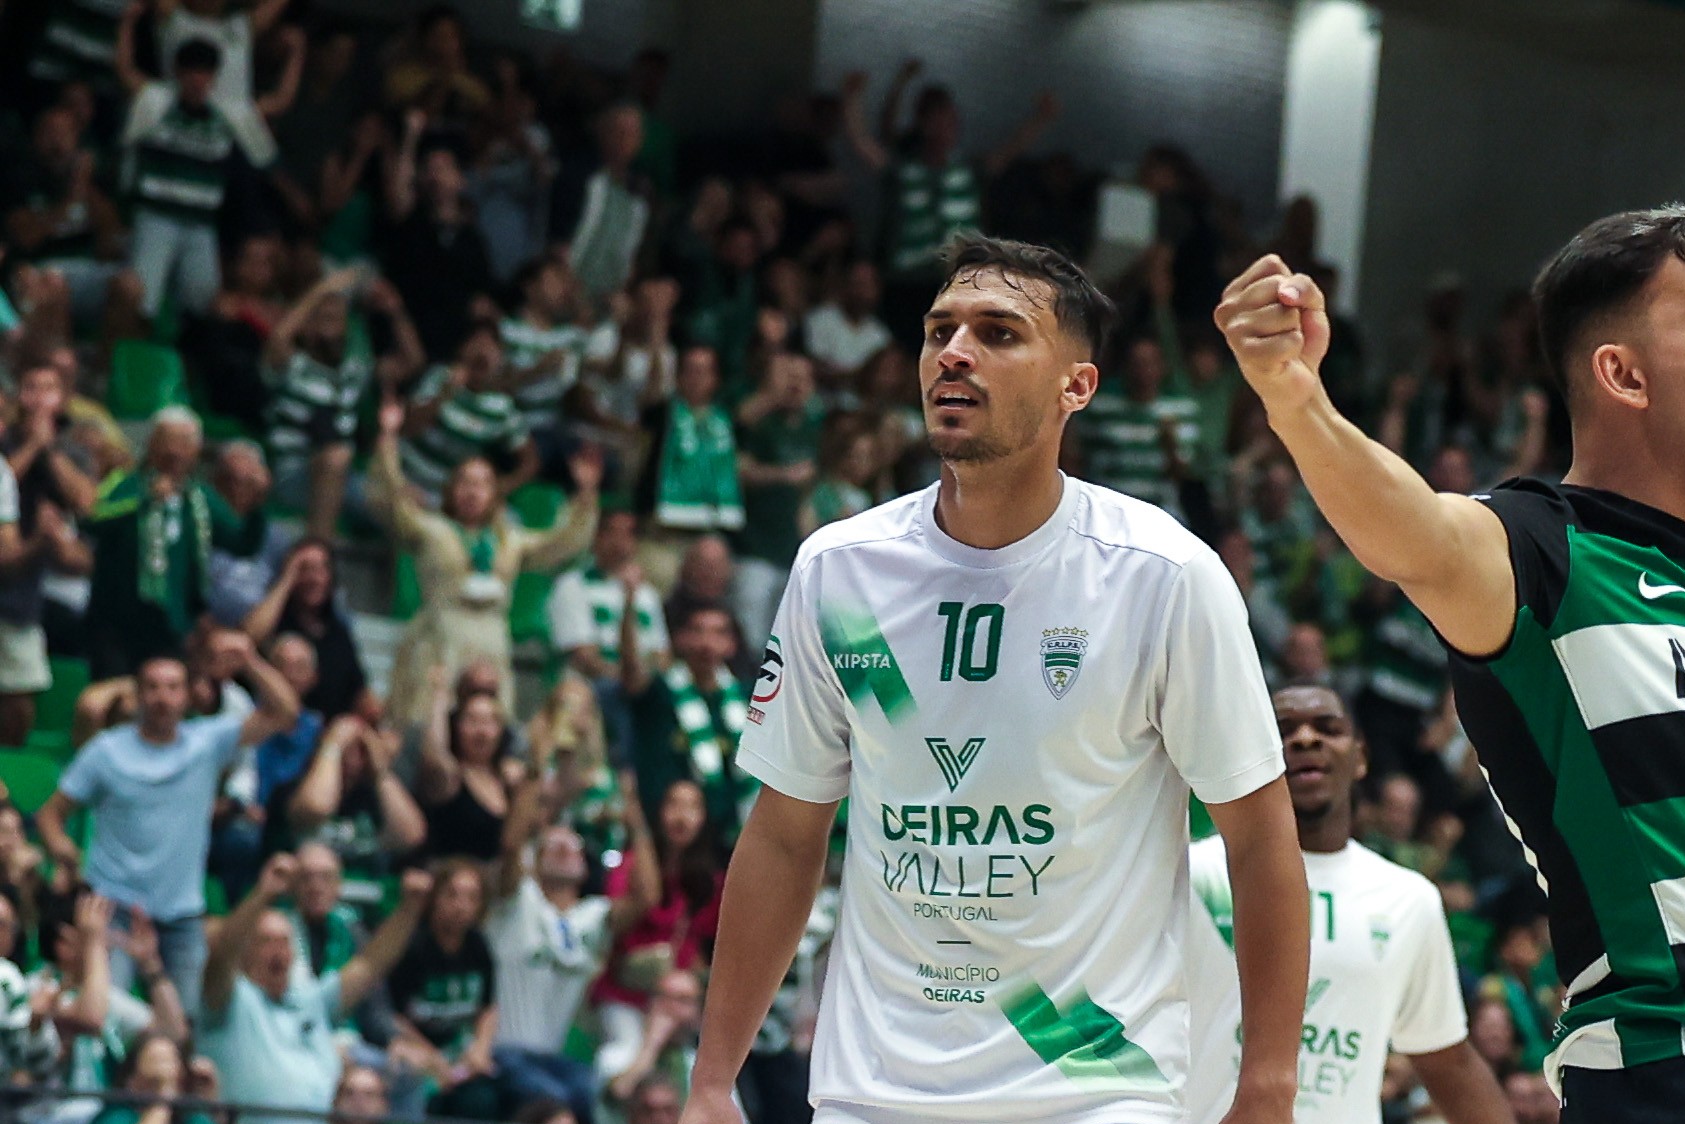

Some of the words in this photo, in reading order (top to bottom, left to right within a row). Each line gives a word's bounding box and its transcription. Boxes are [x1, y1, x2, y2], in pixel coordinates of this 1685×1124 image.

[937, 602, 1006, 681] 10
[833, 653, 892, 669] KIPSTA
[881, 803, 1055, 846] OEIRAS
[879, 849, 1056, 898] VALLEY
[913, 902, 999, 922] PORTUGAL
[916, 963, 1001, 982] MUNICÍPIO
[923, 987, 986, 1004] OEIRAS
